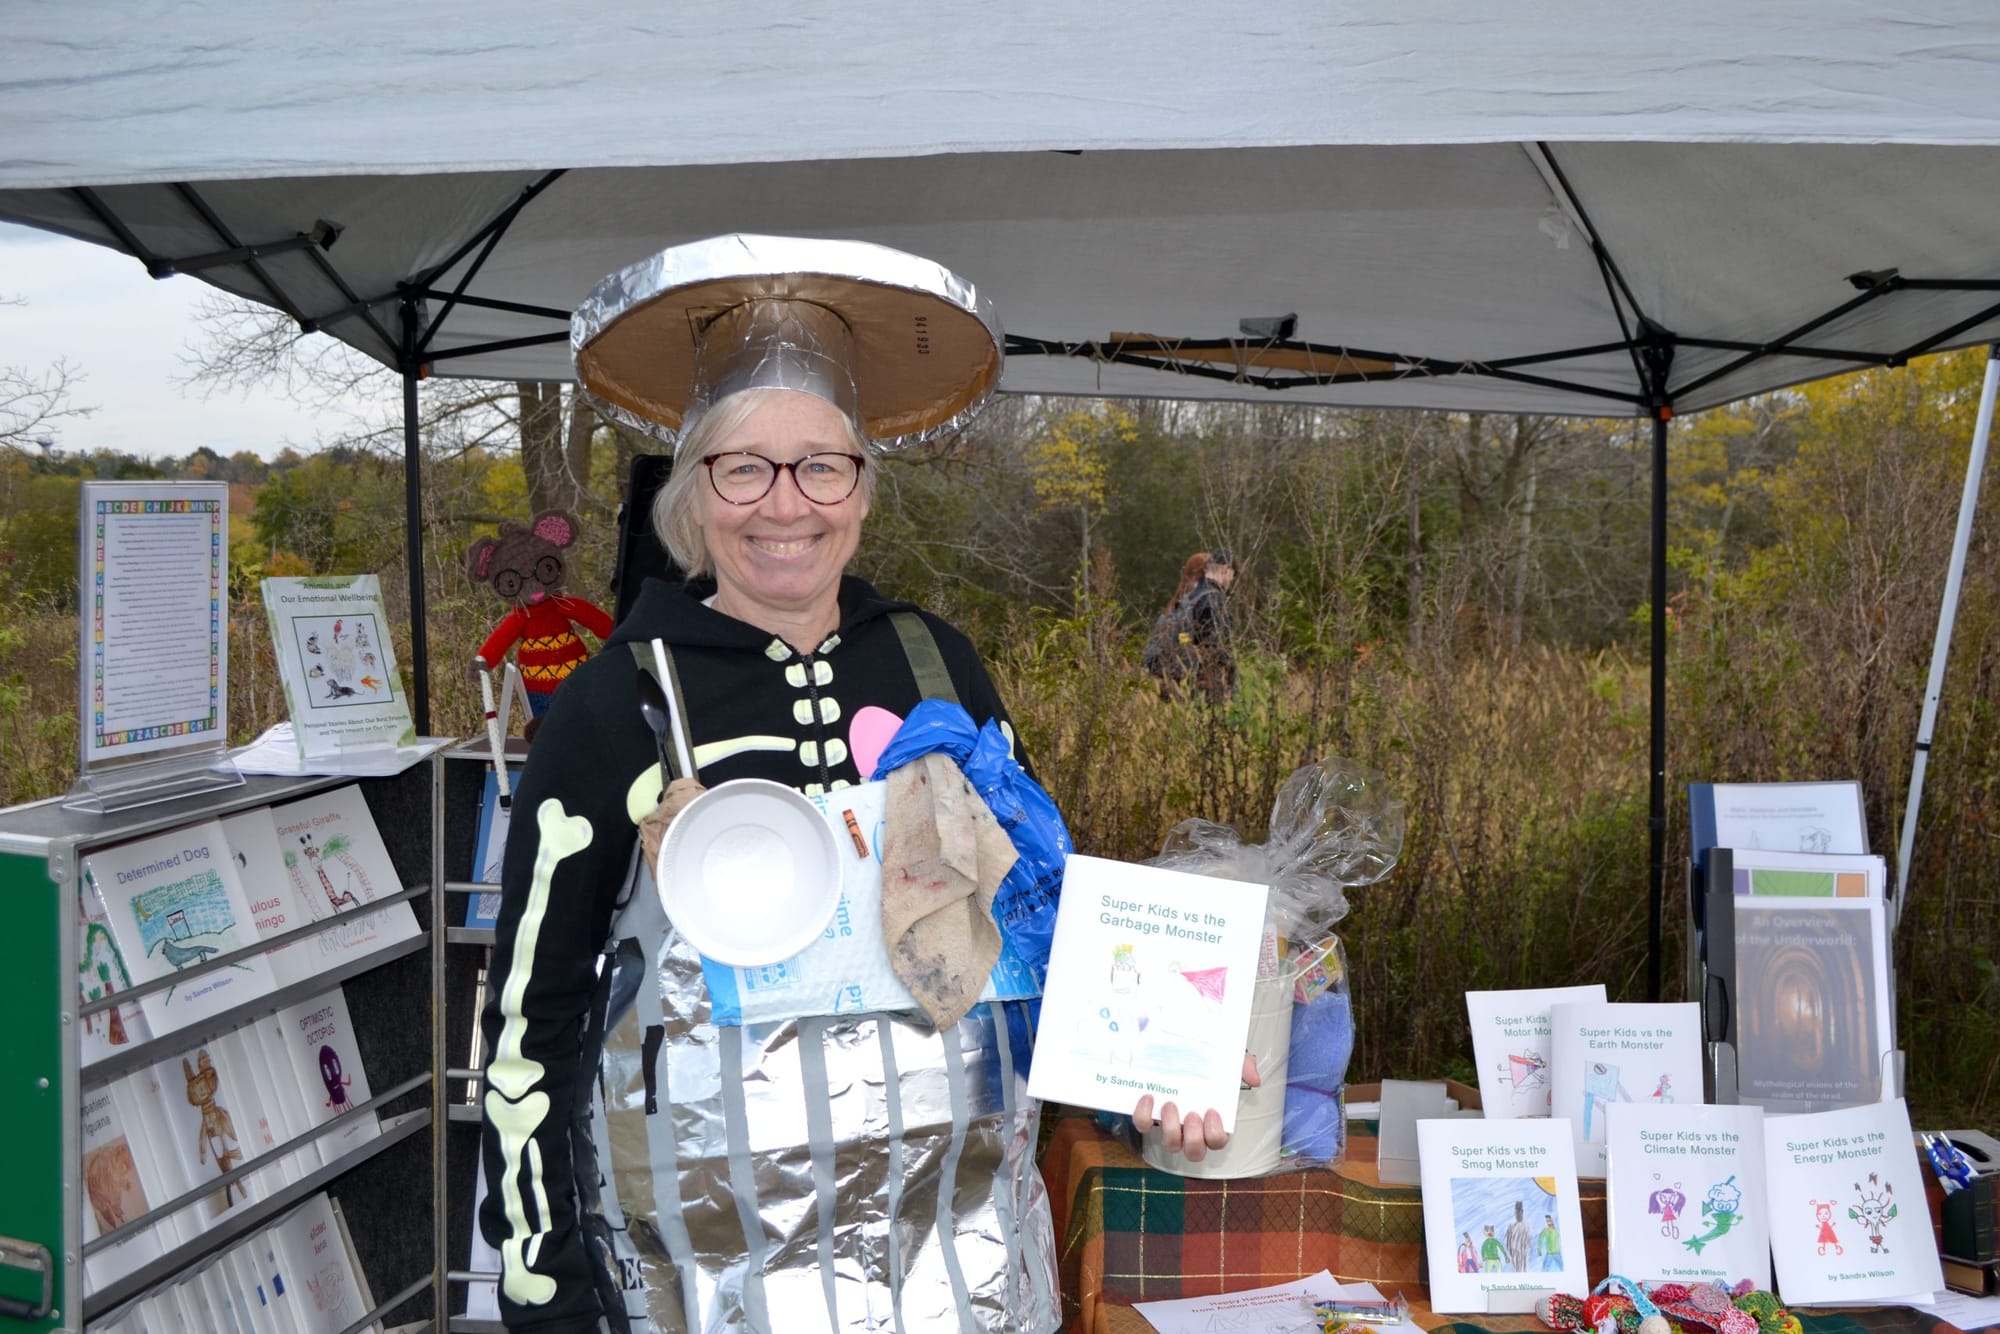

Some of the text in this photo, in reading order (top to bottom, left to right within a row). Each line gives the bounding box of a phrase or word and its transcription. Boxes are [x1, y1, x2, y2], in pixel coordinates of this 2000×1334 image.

[339, 593, 378, 602] Wellbeing
[277, 812, 342, 837] Grateful Giraffe
[117, 846, 210, 885] Determined Dog
[1101, 894, 1226, 928] Super Kids vs the
[1099, 912, 1223, 945] Garbage Monster
[1753, 916, 1836, 928] An Overview
[1749, 934, 1771, 945] the
[1495, 1015, 1548, 1026] Super Kids
[306, 1023, 336, 1047] OCTOPUS
[1504, 1028, 1531, 1037] Motor
[1579, 1027, 1672, 1039] Super Kids vs the
[1589, 1040, 1664, 1050] Earth Monster
[1096, 1073, 1179, 1096] by Sandra Wilson
[1753, 1080, 1801, 1091] Mythological
[1639, 1130, 1740, 1143] Super Kids vs the
[1786, 1131, 1885, 1153] Super Kids vs the
[1451, 1144, 1547, 1159] Super Kids vs the
[1643, 1144, 1736, 1156] Climate Monster
[1794, 1145, 1883, 1165] Energy Monster
[1461, 1158, 1539, 1171] Smog Monster
[1661, 1267, 1726, 1277] by Sandra Wilson
[1827, 1269, 1895, 1282] by Sandra Wilson
